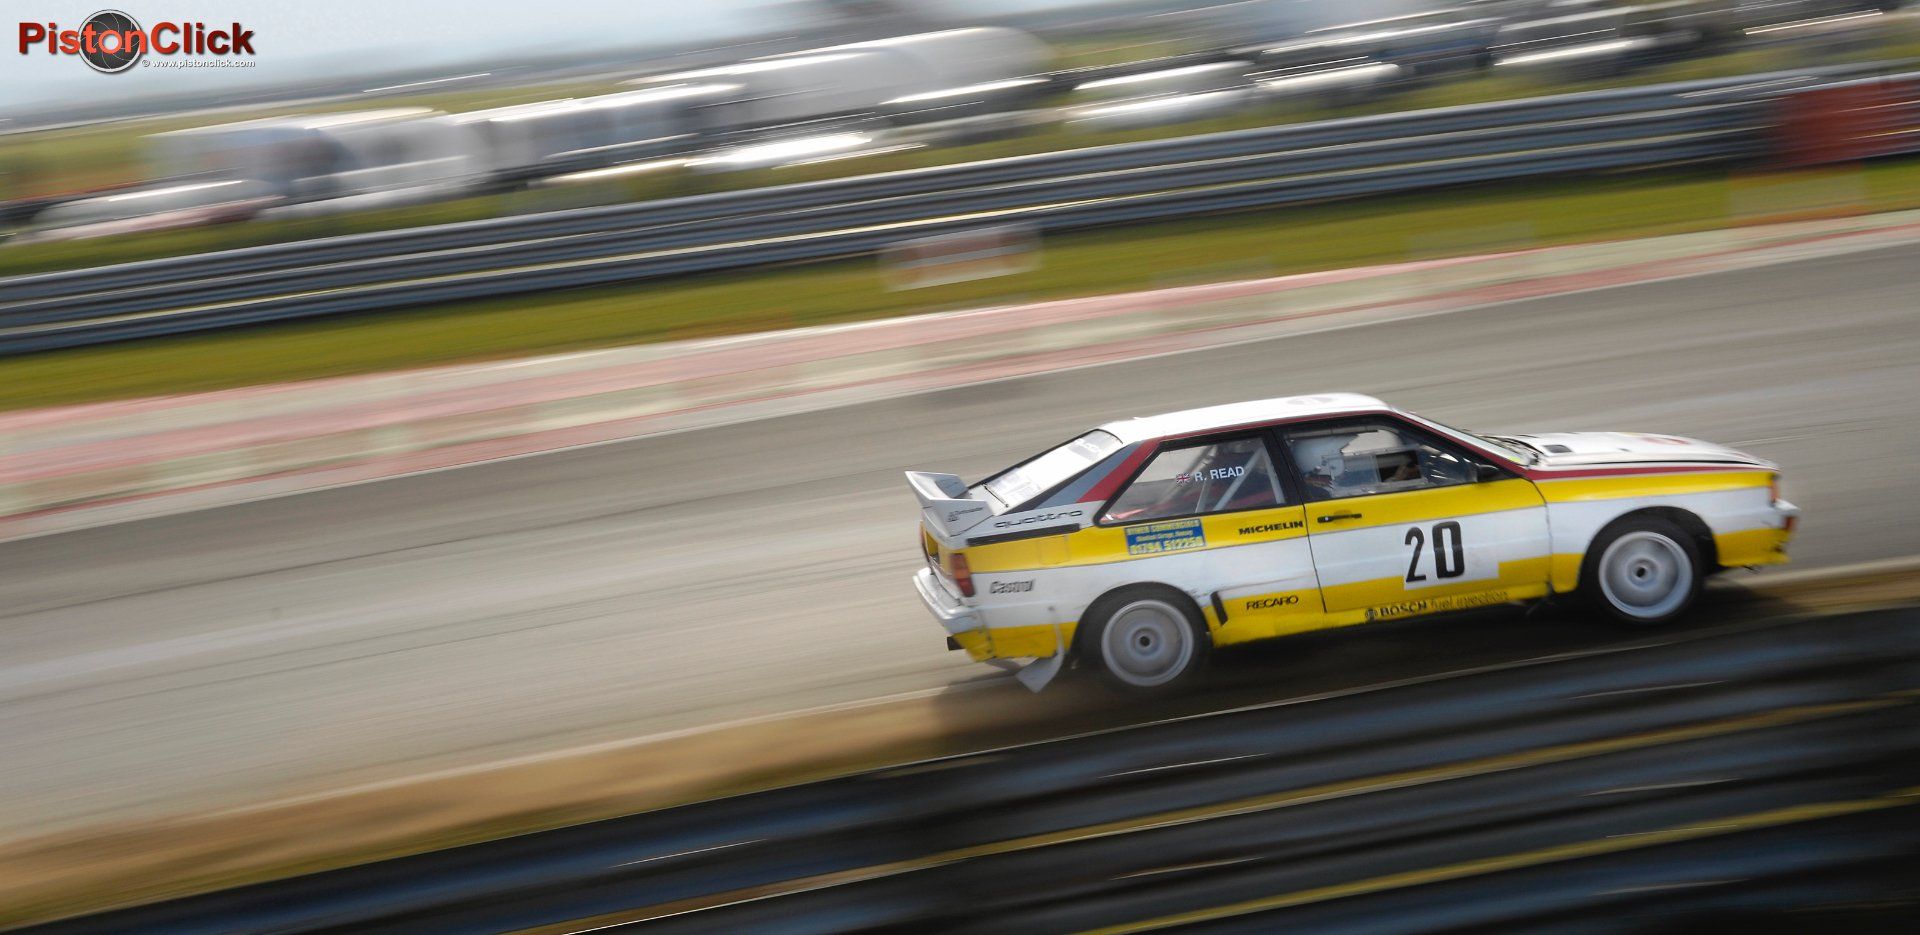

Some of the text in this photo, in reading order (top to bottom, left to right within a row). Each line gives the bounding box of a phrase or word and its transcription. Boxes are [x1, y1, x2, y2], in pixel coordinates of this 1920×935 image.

[1194, 466, 1244, 482] R. READ
[994, 510, 1083, 528] quattro
[1238, 520, 1304, 535] MICHELIN
[1404, 521, 1465, 582] 20
[990, 578, 1035, 594] Castrol
[1246, 595, 1299, 610] RECARO
[1380, 601, 1427, 617] BOSCH
